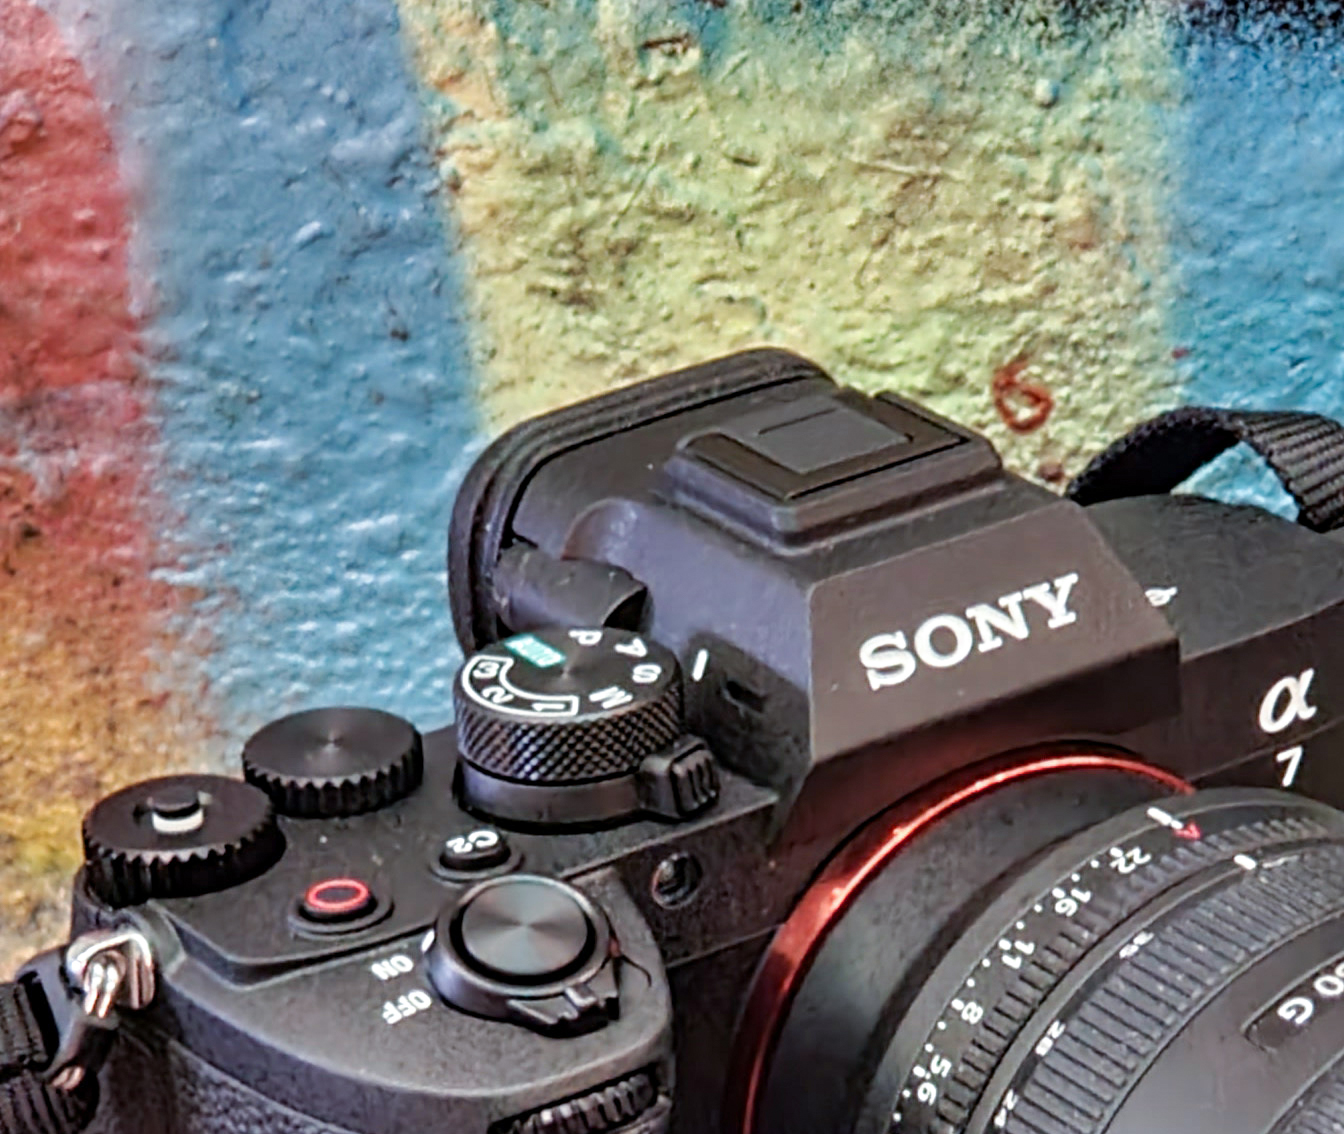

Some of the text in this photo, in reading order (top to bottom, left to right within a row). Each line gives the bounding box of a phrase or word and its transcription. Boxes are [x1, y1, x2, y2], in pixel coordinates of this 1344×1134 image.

[568, 629, 603, 645] P
[859, 572, 1078, 692] SONY
[472, 661, 500, 679] 3
[631, 663, 662, 684] S
[482, 685, 515, 704] 2
[531, 701, 566, 712] 1
[588, 685, 633, 709] M
[1258, 668, 1317, 734] α
[1276, 745, 1305, 788] 7
[446, 829, 499, 854] C2
[370, 953, 414, 981] ON
[916, 1053, 952, 1107] 5.6
[961, 1001, 985, 1025] 8
[1000, 940, 1036, 970] 11
[1054, 887, 1092, 918] 16
[1109, 845, 1153, 874] 22
[381, 988, 433, 1025] OFF
[1276, 995, 1314, 1026] G
